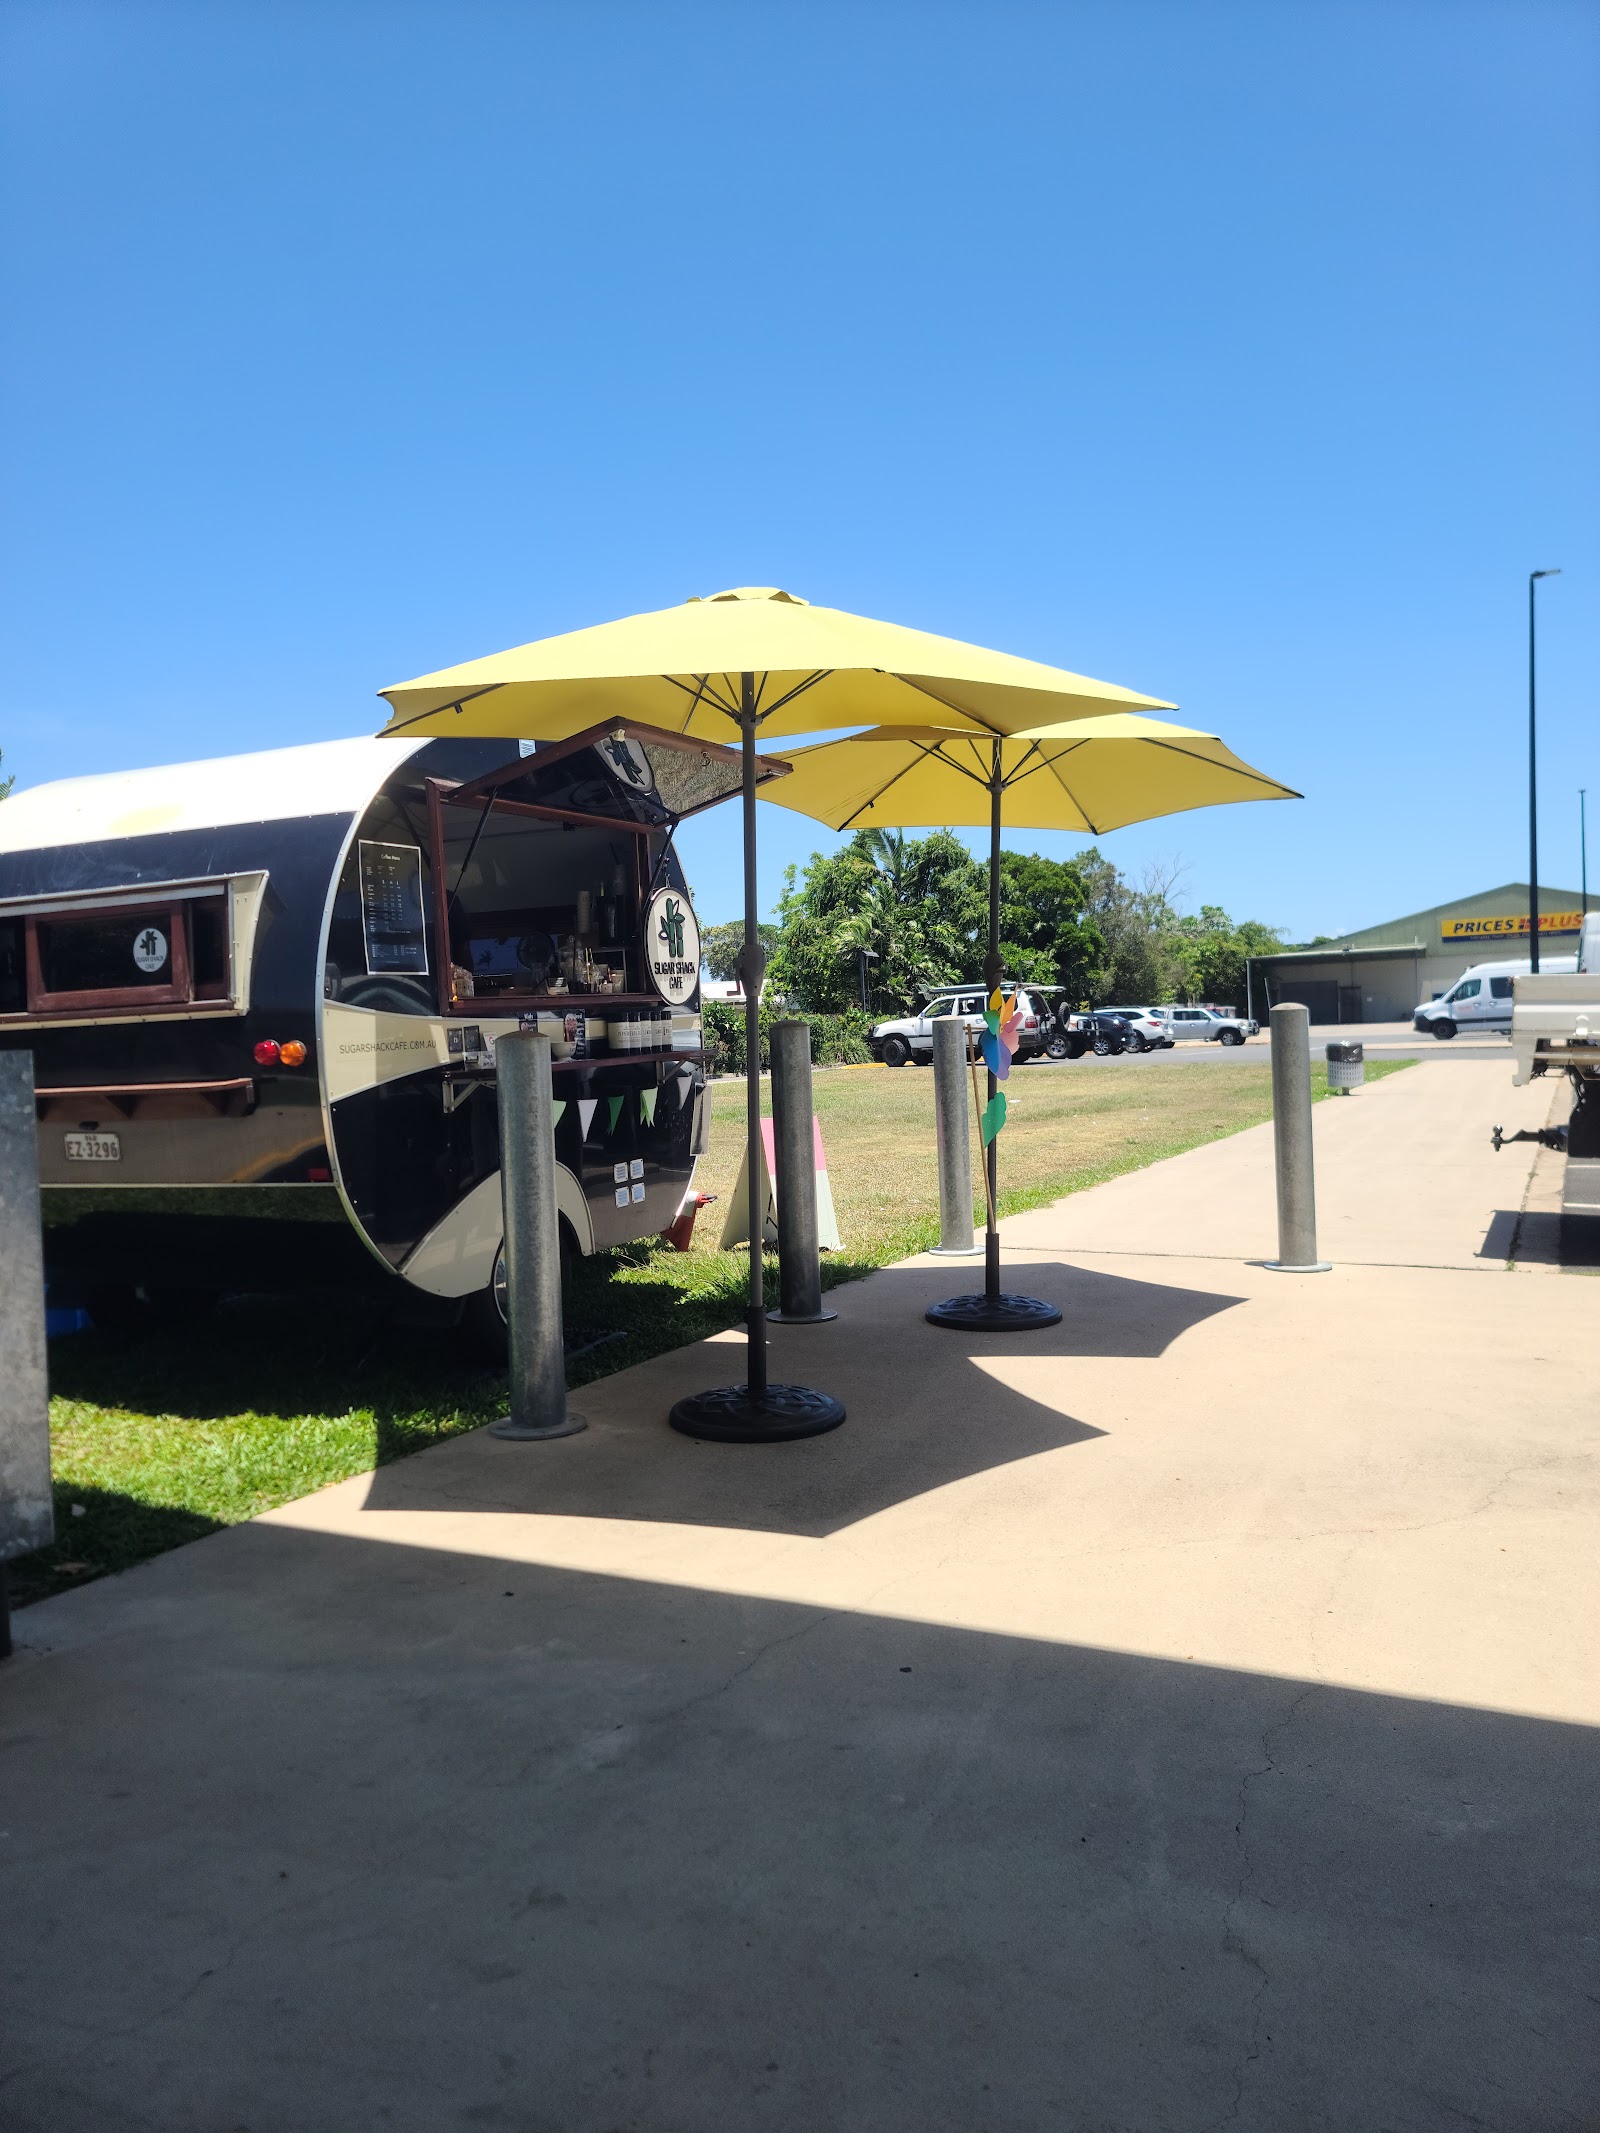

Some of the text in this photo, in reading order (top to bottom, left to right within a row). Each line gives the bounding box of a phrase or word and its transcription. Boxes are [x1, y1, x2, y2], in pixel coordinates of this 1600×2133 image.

[1453, 913, 1583, 934] PRICES PLUS
[654, 961, 696, 975] SUGAR SHACK
[669, 976, 684, 990] CAFE
[339, 1040, 437, 1054] SUGARSHACKCAFE.COM.AU
